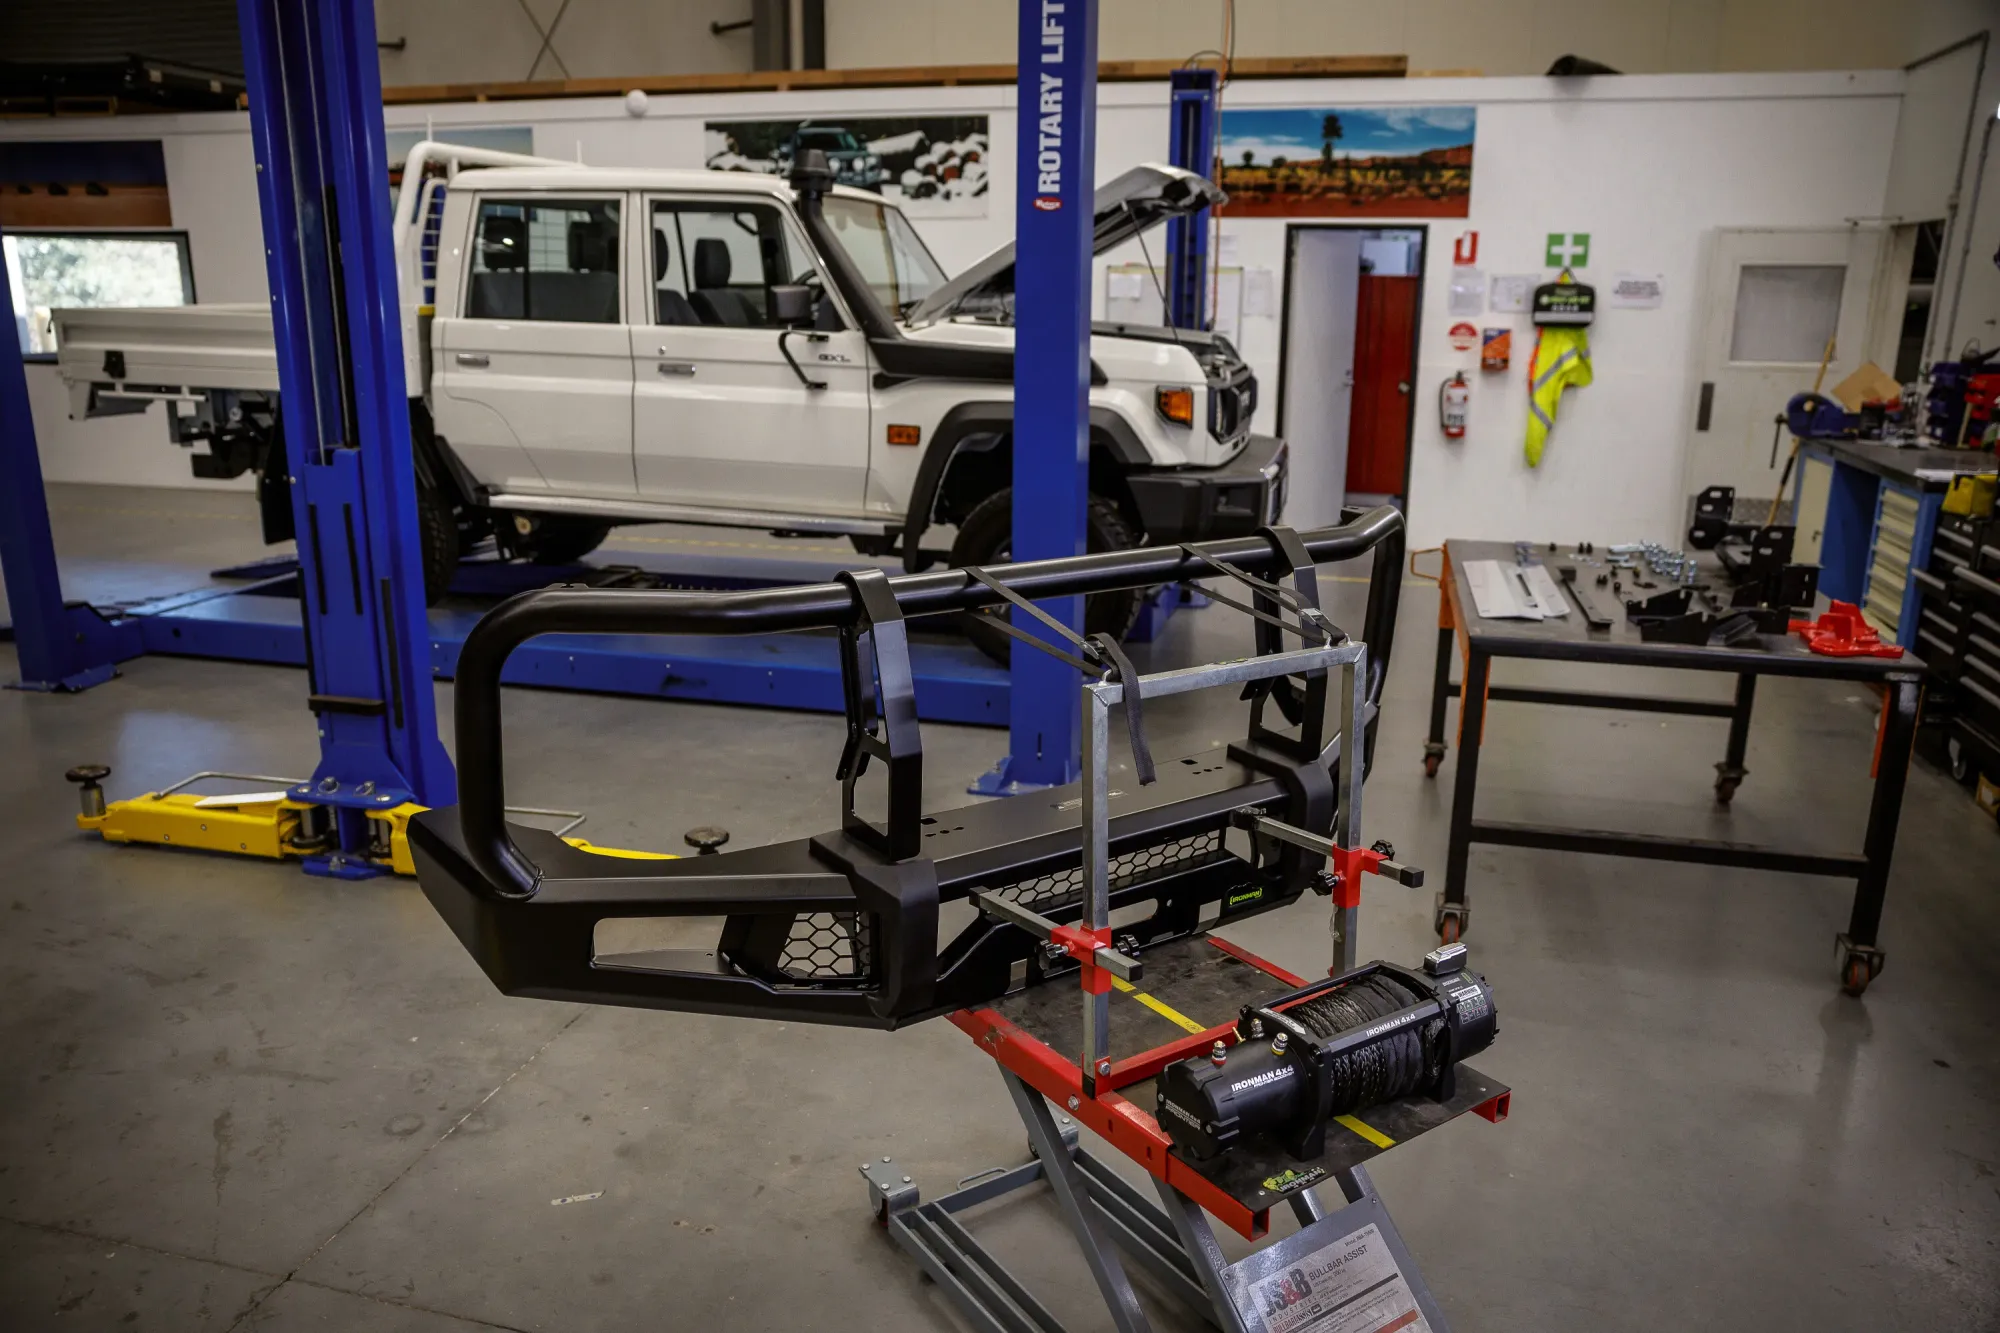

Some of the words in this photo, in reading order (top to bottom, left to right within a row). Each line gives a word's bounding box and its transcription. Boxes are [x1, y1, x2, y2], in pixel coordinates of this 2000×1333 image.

[1041, 0, 1065, 63] LIFT
[1038, 73, 1063, 193] ROTARY
[1366, 1020, 1400, 1037] IRONMAN
[1401, 1013, 1416, 1024] 4x4
[1231, 1070, 1275, 1092] IRONMAN
[1275, 1064, 1294, 1077] 4x4
[1308, 1258, 1343, 1281] BULLBAR
[1344, 1245, 1368, 1263] ASSIST
[1268, 1295, 1317, 1324] INDUSTRIES
